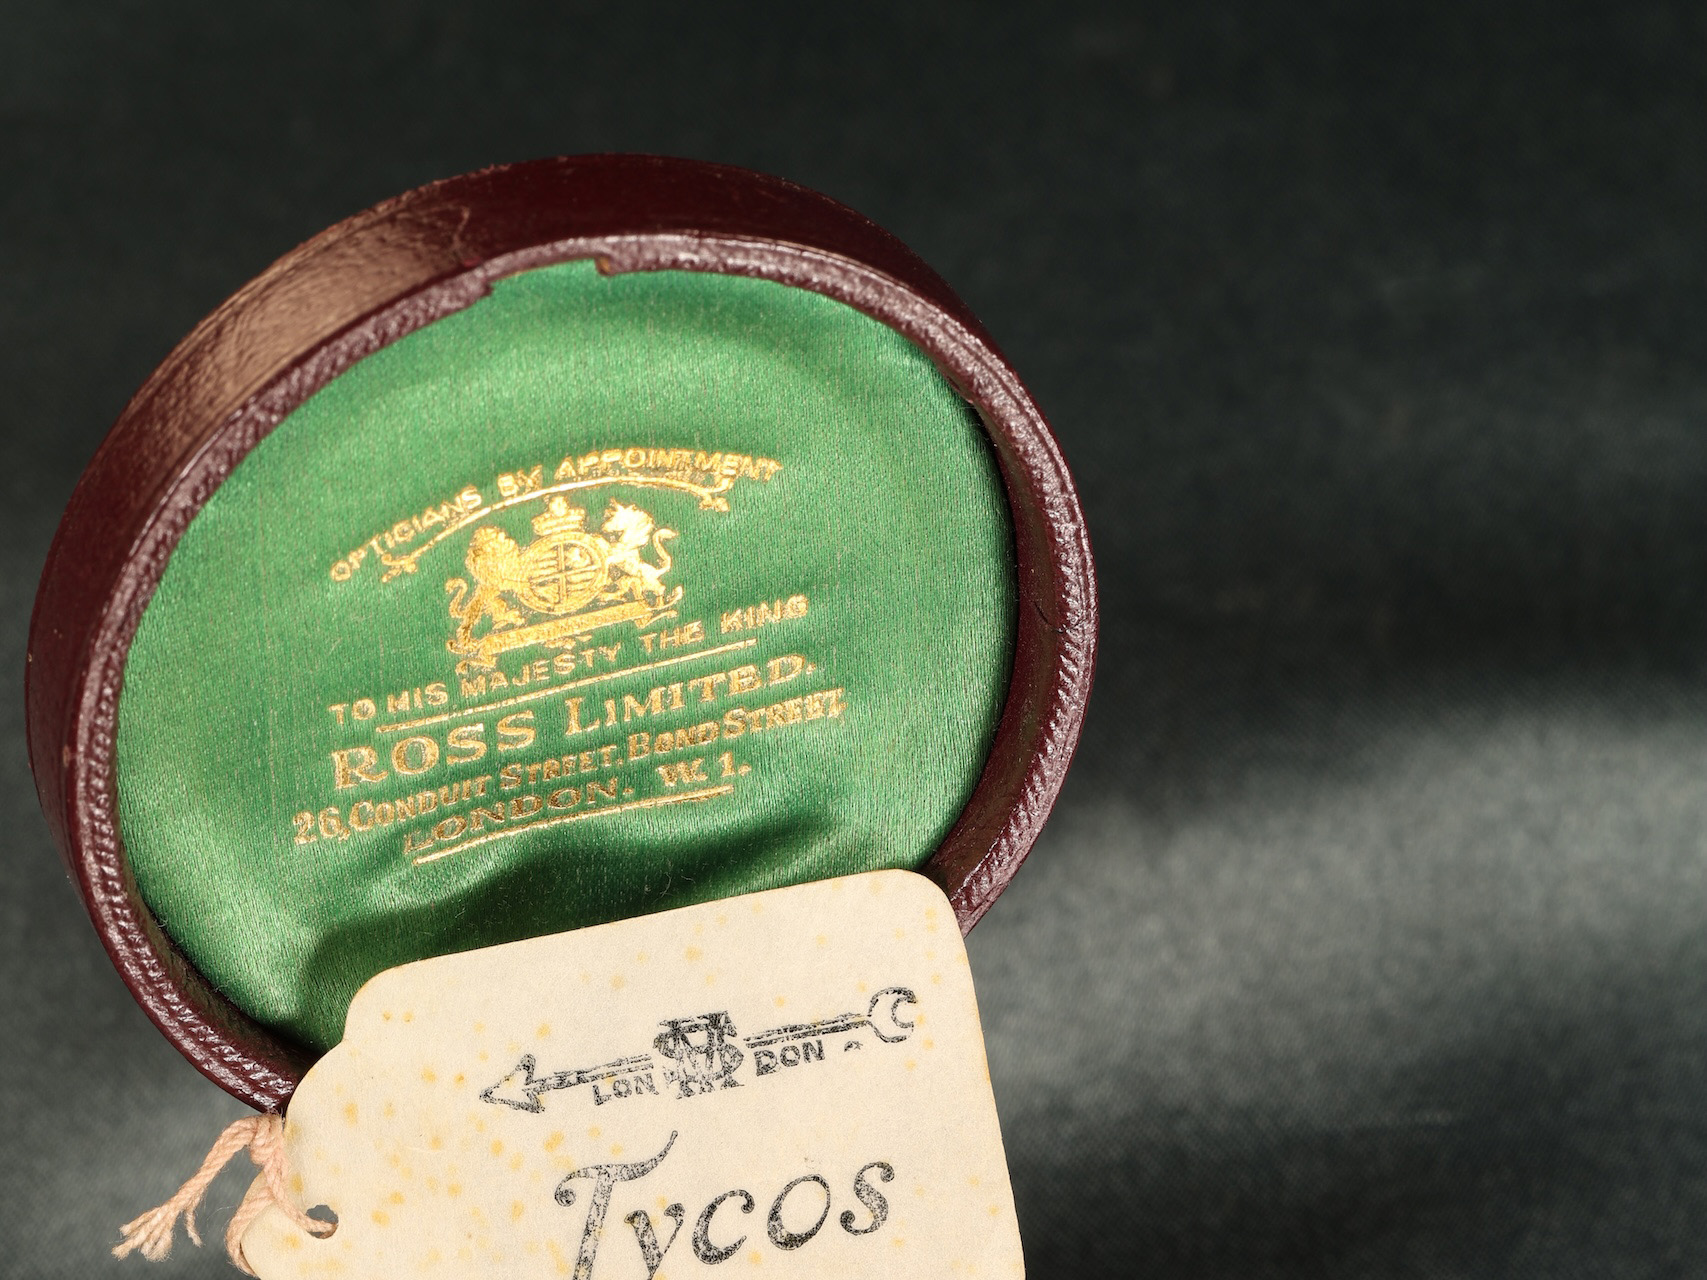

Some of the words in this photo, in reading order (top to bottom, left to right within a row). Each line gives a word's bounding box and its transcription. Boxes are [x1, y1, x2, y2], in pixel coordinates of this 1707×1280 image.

[329, 484, 483, 583] OPTICIANS
[497, 463, 543, 497] BY
[553, 447, 784, 483] APPOINTMENT
[329, 698, 375, 726] TO
[386, 681, 448, 716] HIS
[461, 642, 622, 698] MAJESTY
[638, 620, 705, 654] THE
[720, 594, 810, 634] KING
[330, 708, 538, 790] ROSS
